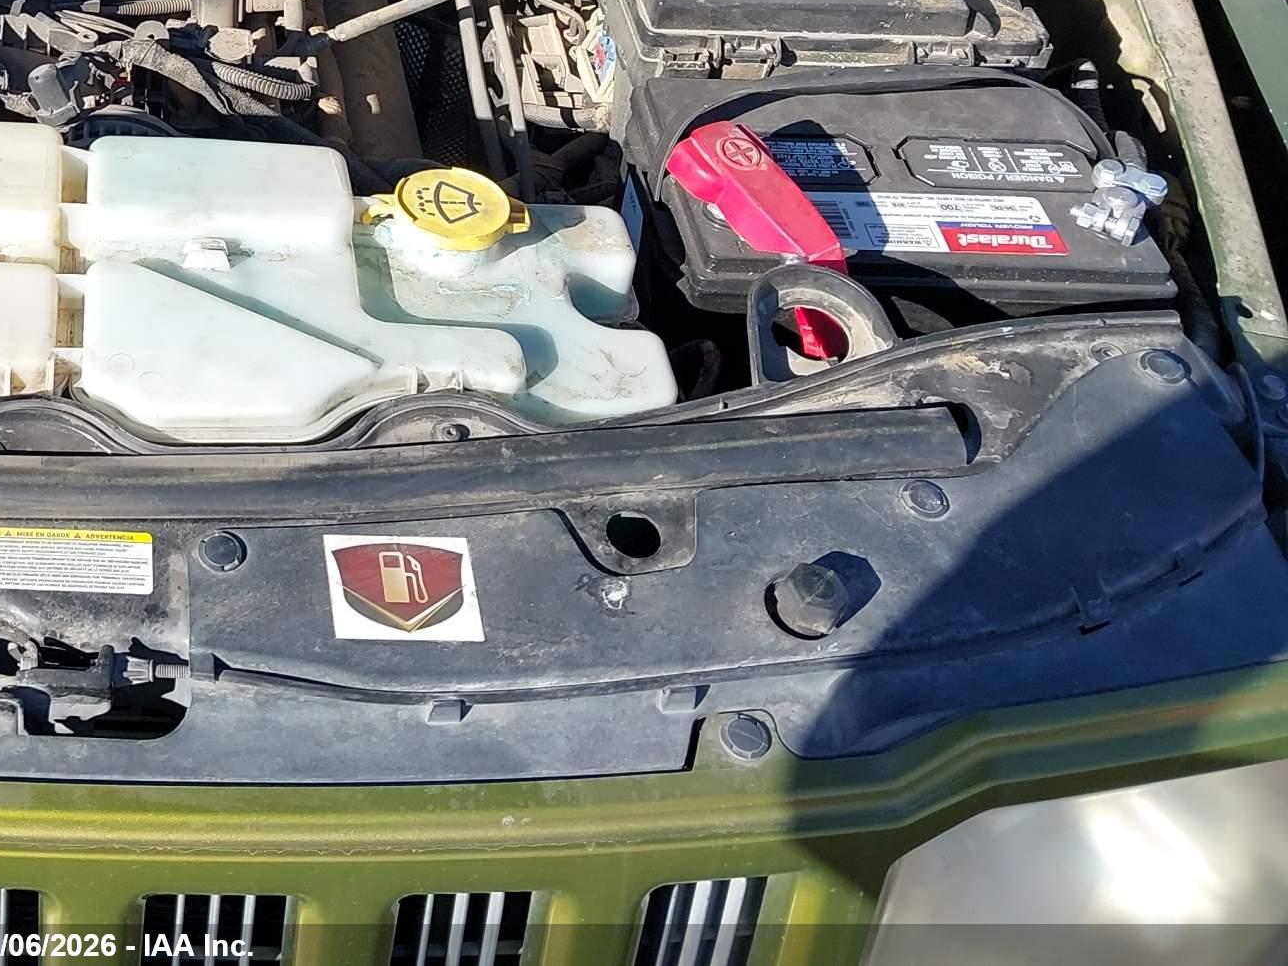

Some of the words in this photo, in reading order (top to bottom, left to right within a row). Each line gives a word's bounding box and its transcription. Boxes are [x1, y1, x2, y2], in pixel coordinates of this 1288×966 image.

[951, 172, 994, 181] POISON
[1005, 174, 1054, 183] DANGER
[957, 233, 1054, 249] Duralast
